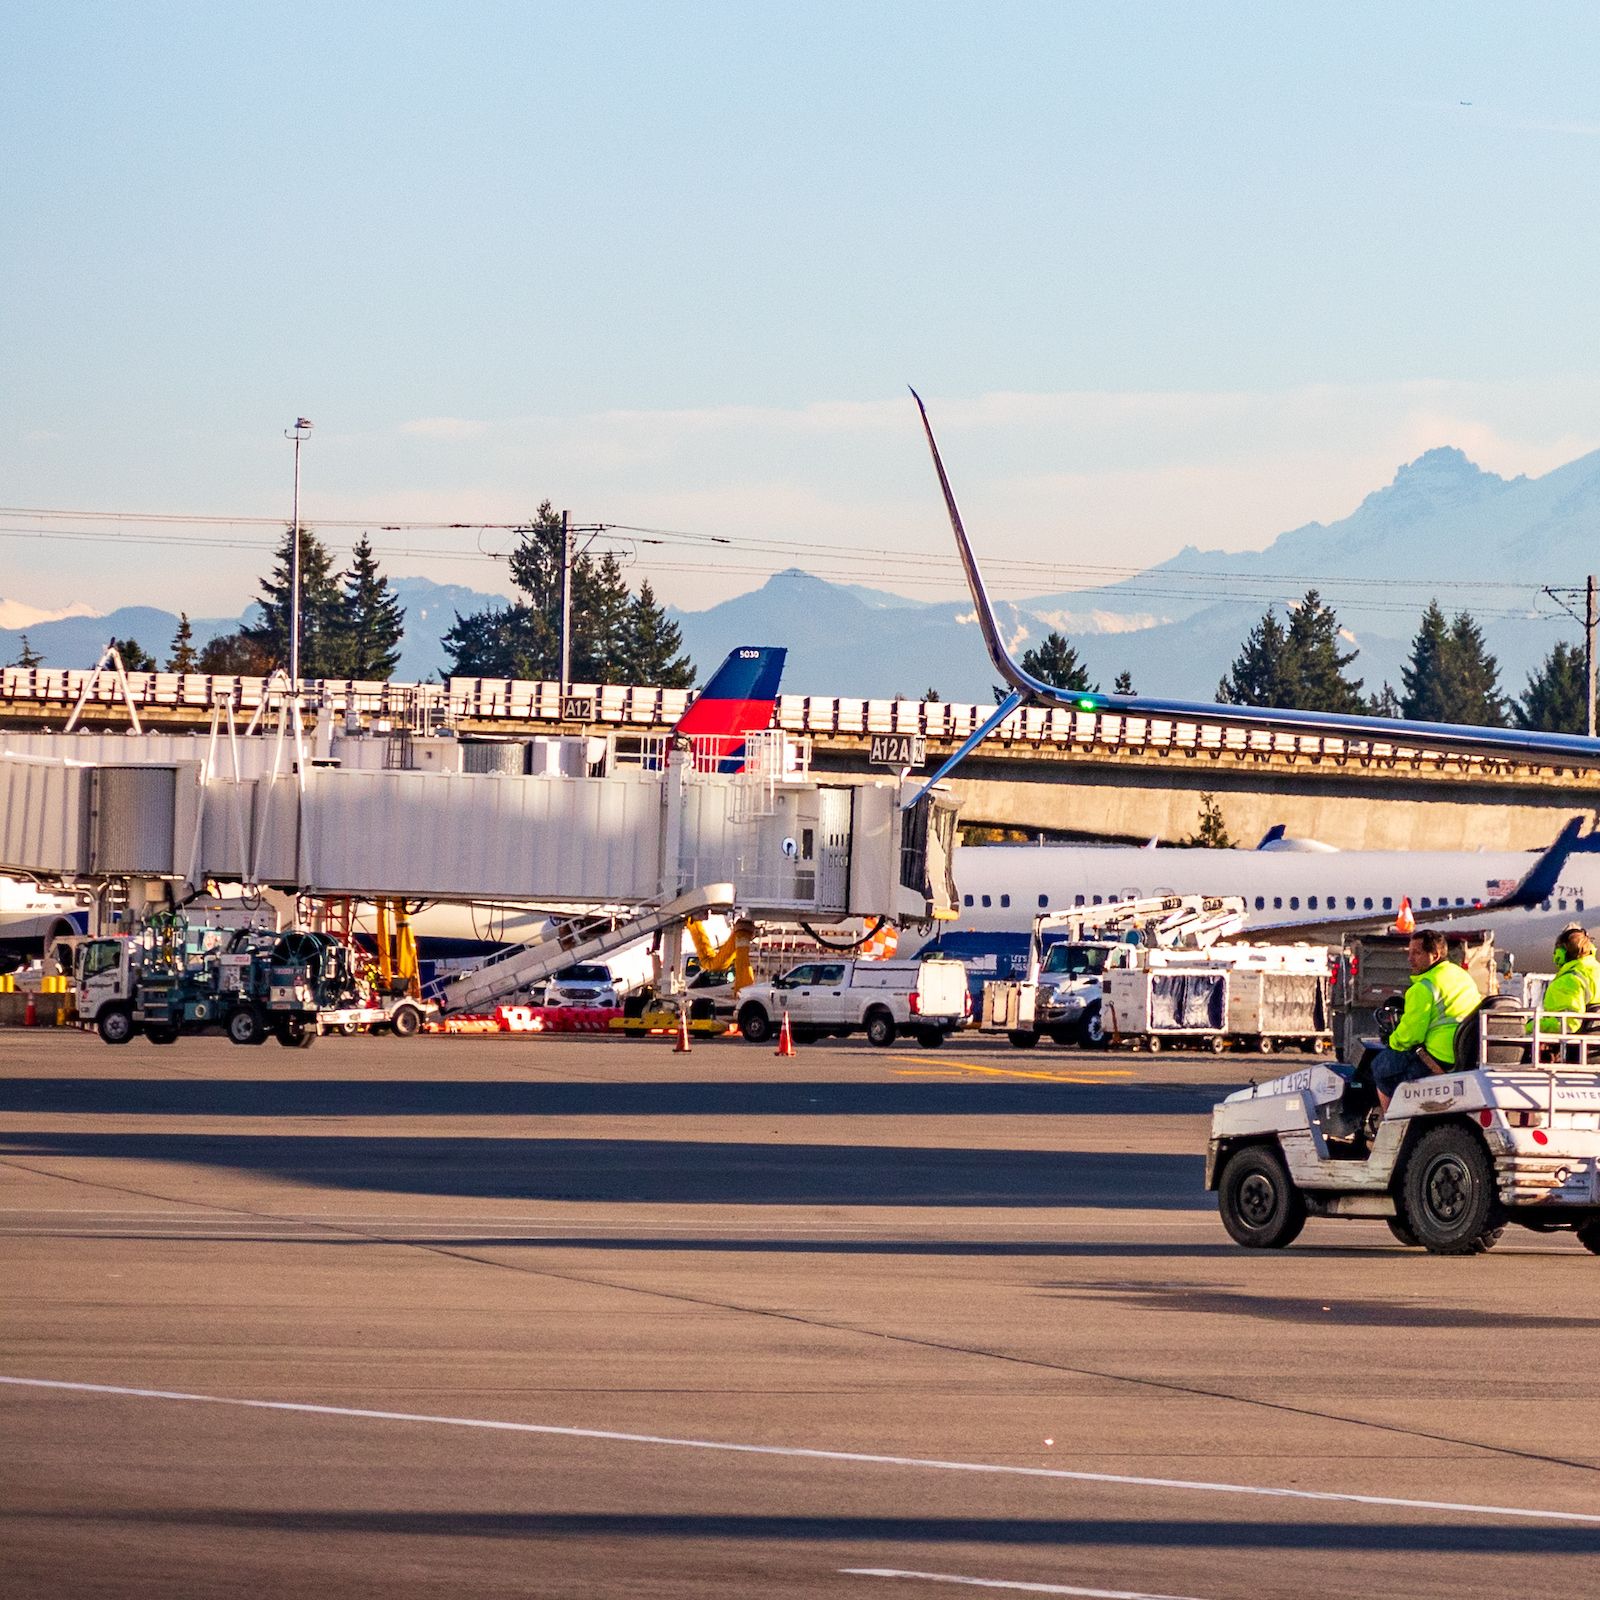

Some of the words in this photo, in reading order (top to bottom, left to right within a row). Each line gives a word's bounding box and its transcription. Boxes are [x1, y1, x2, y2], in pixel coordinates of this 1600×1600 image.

[565, 700, 590, 717] A12
[872, 737, 909, 761] A12A
[1272, 1076, 1285, 1095] CT
[1287, 1072, 1309, 1092] 4125
[1404, 1086, 1450, 1099] UNITED
